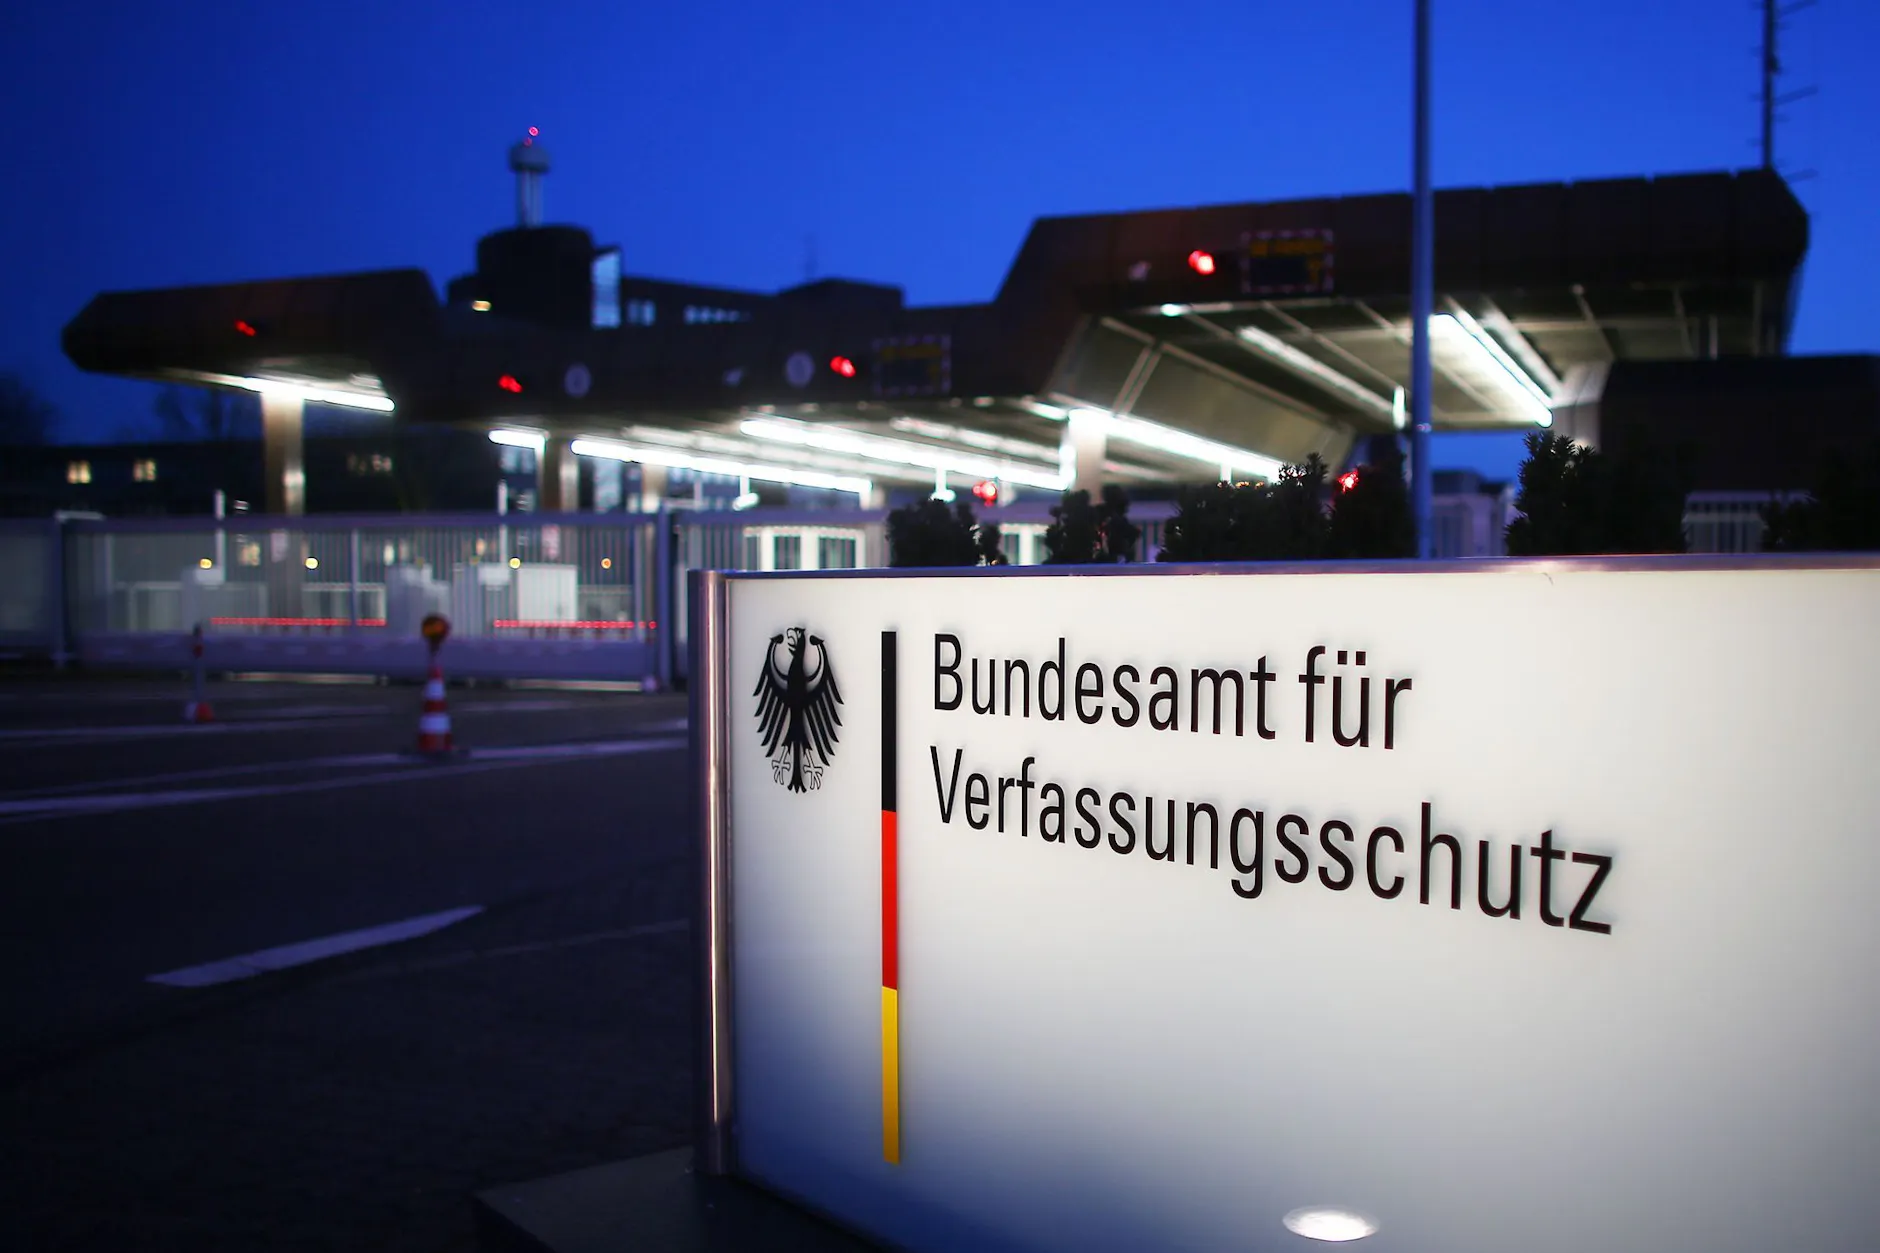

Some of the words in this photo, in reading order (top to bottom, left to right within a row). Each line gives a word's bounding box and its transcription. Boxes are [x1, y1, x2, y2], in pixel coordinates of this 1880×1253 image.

[934, 632, 1277, 740] Bundesamt
[1298, 645, 1413, 750] für
[930, 745, 1613, 935] Verfassungsschutz
